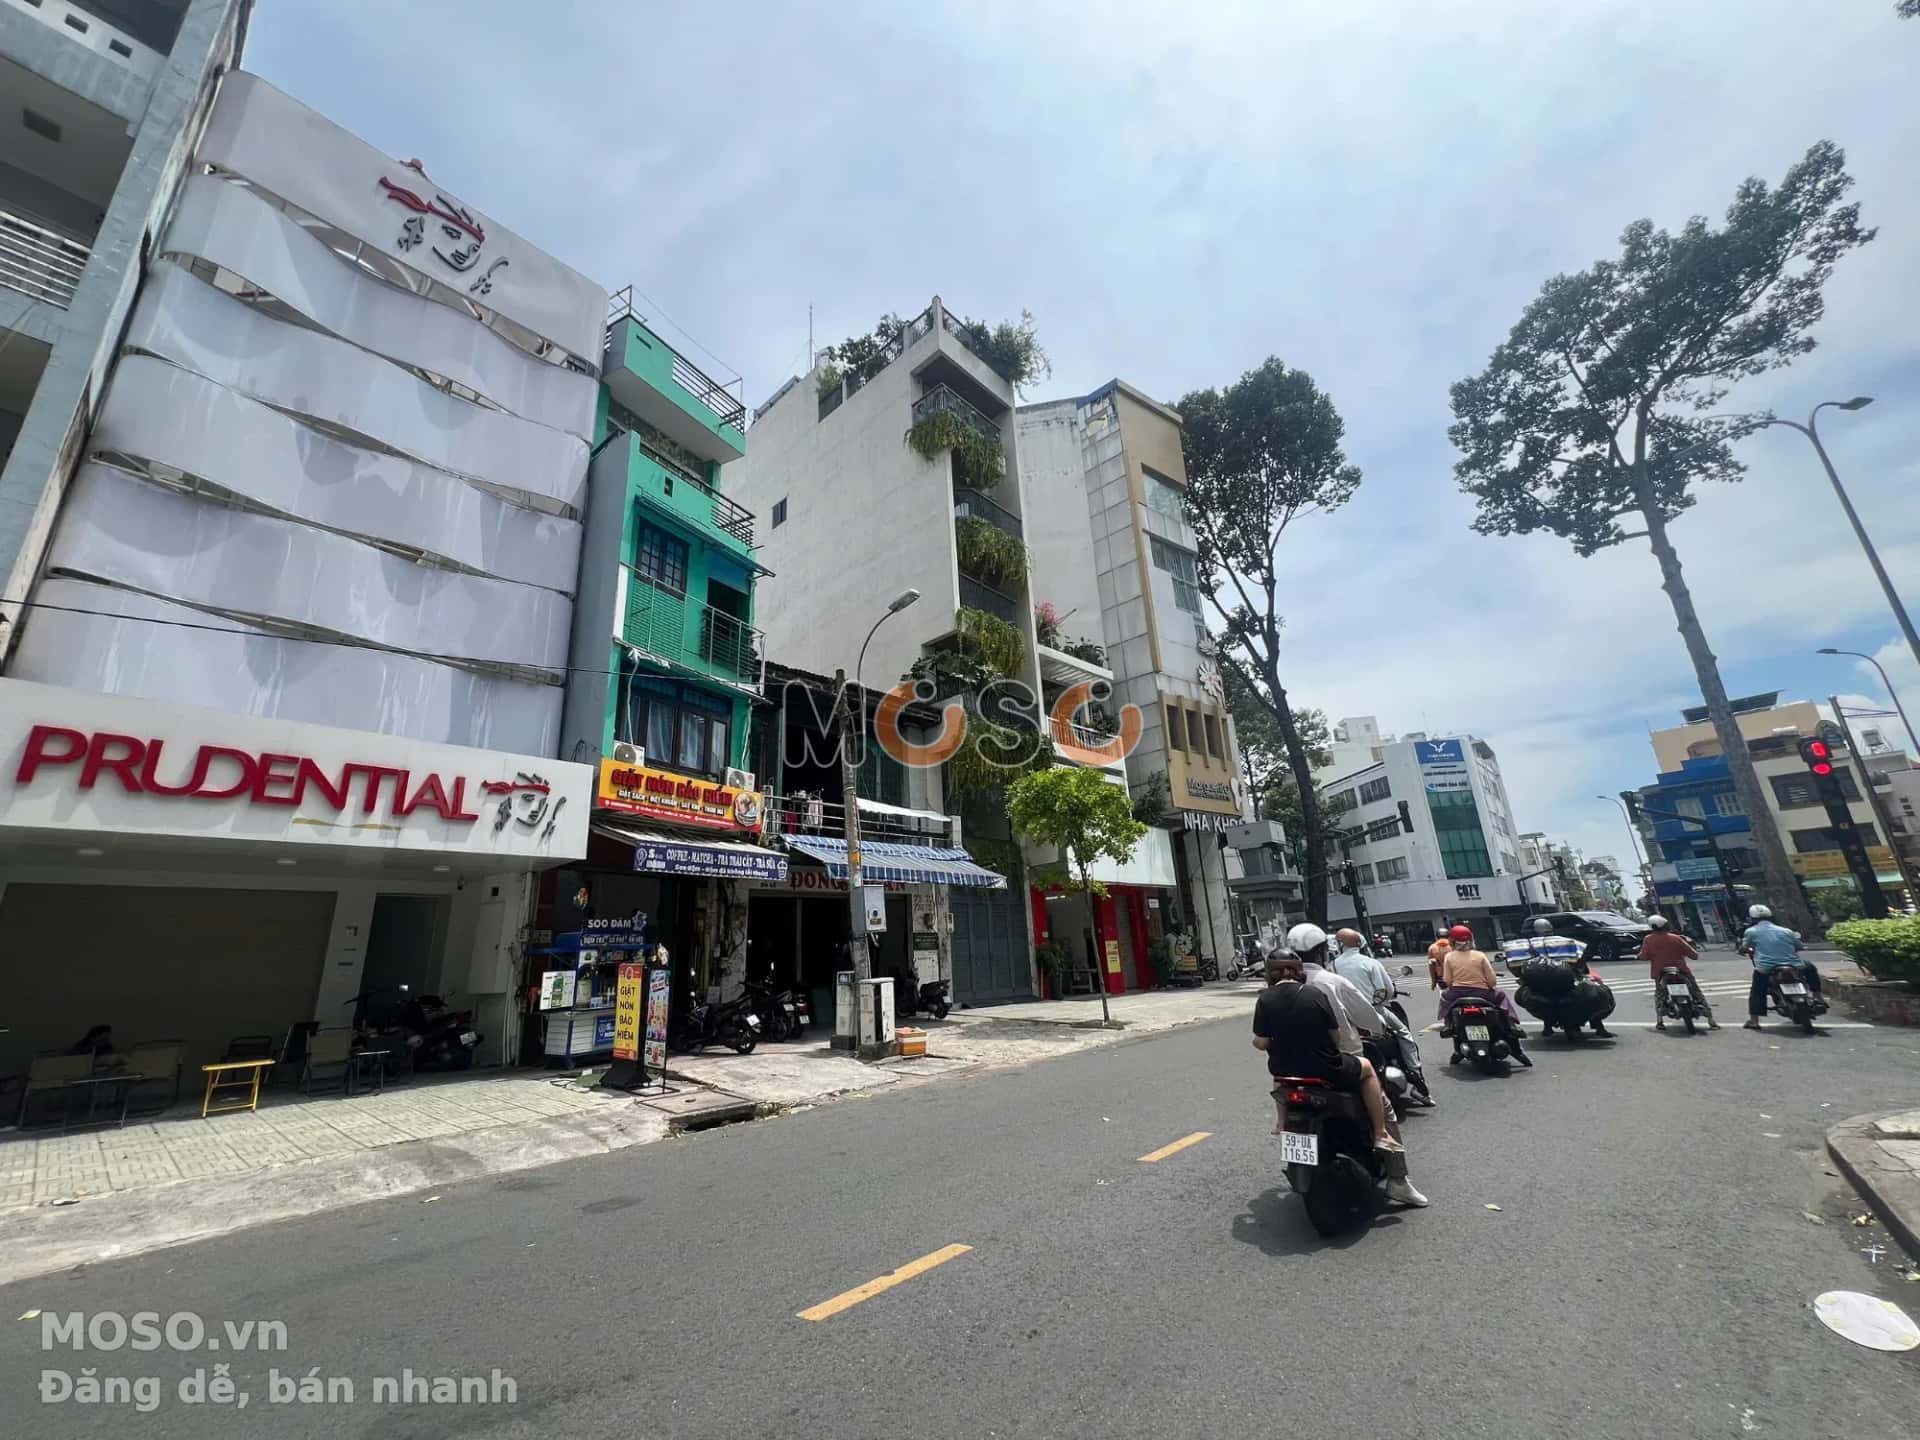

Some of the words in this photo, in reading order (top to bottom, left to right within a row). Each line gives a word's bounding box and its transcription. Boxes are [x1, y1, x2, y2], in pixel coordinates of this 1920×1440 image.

[16, 724, 480, 822] PRUDENTIAL
[1184, 812, 1210, 831] NHA
[666, 849, 689, 861] COFFEE
[691, 852, 714, 864] MATCHA
[587, 919, 609, 928] SOO
